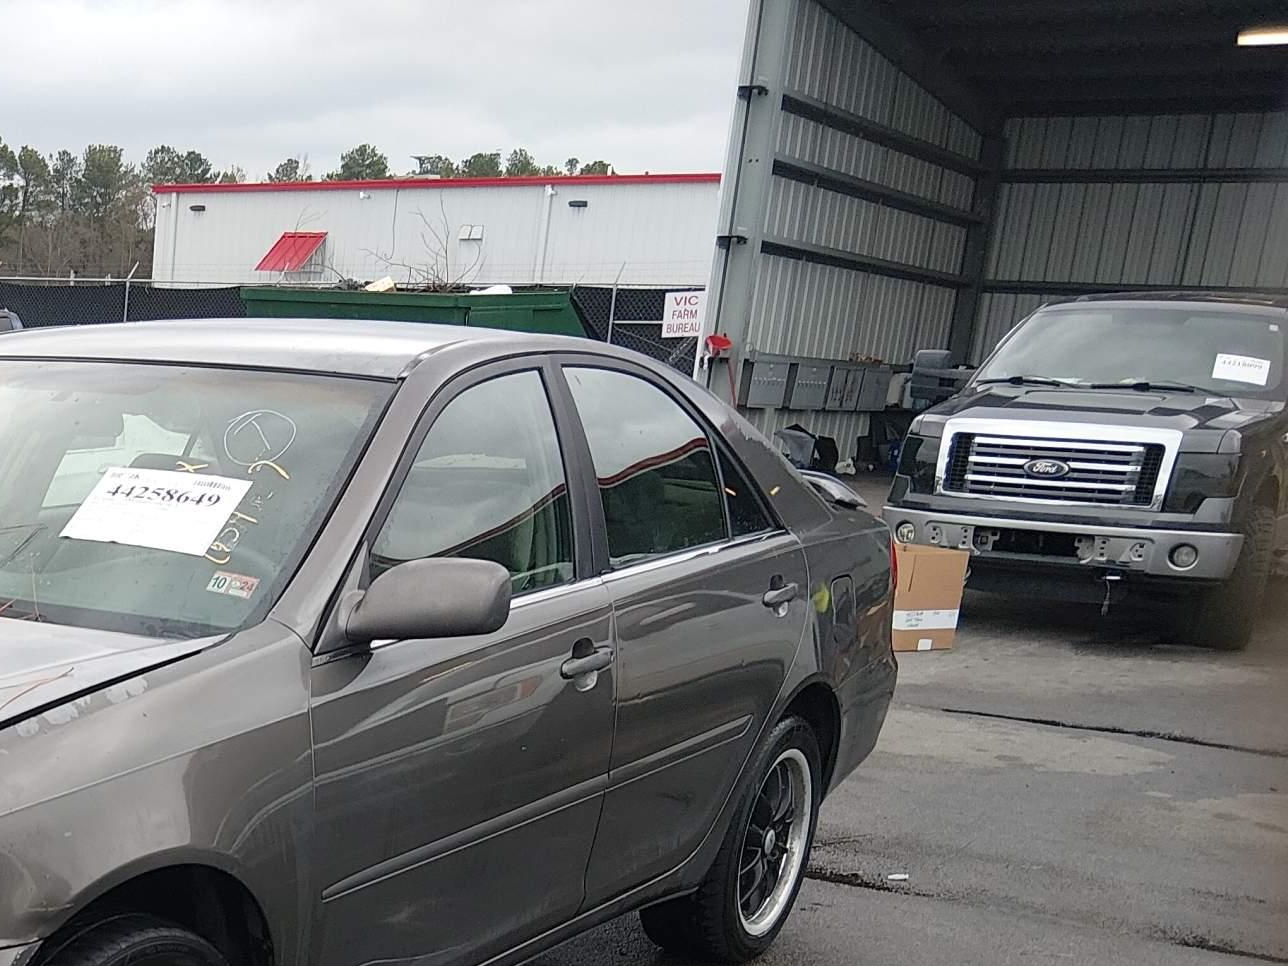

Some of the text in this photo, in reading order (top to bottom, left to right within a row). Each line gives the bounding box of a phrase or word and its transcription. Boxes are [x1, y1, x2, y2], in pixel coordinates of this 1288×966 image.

[674, 295, 699, 306] VIC
[672, 308, 698, 320] FARM
[666, 322, 701, 334] BUREAU
[1032, 461, 1058, 474] Ford
[107, 484, 221, 508] 44258649
[212, 576, 227, 589] 10
